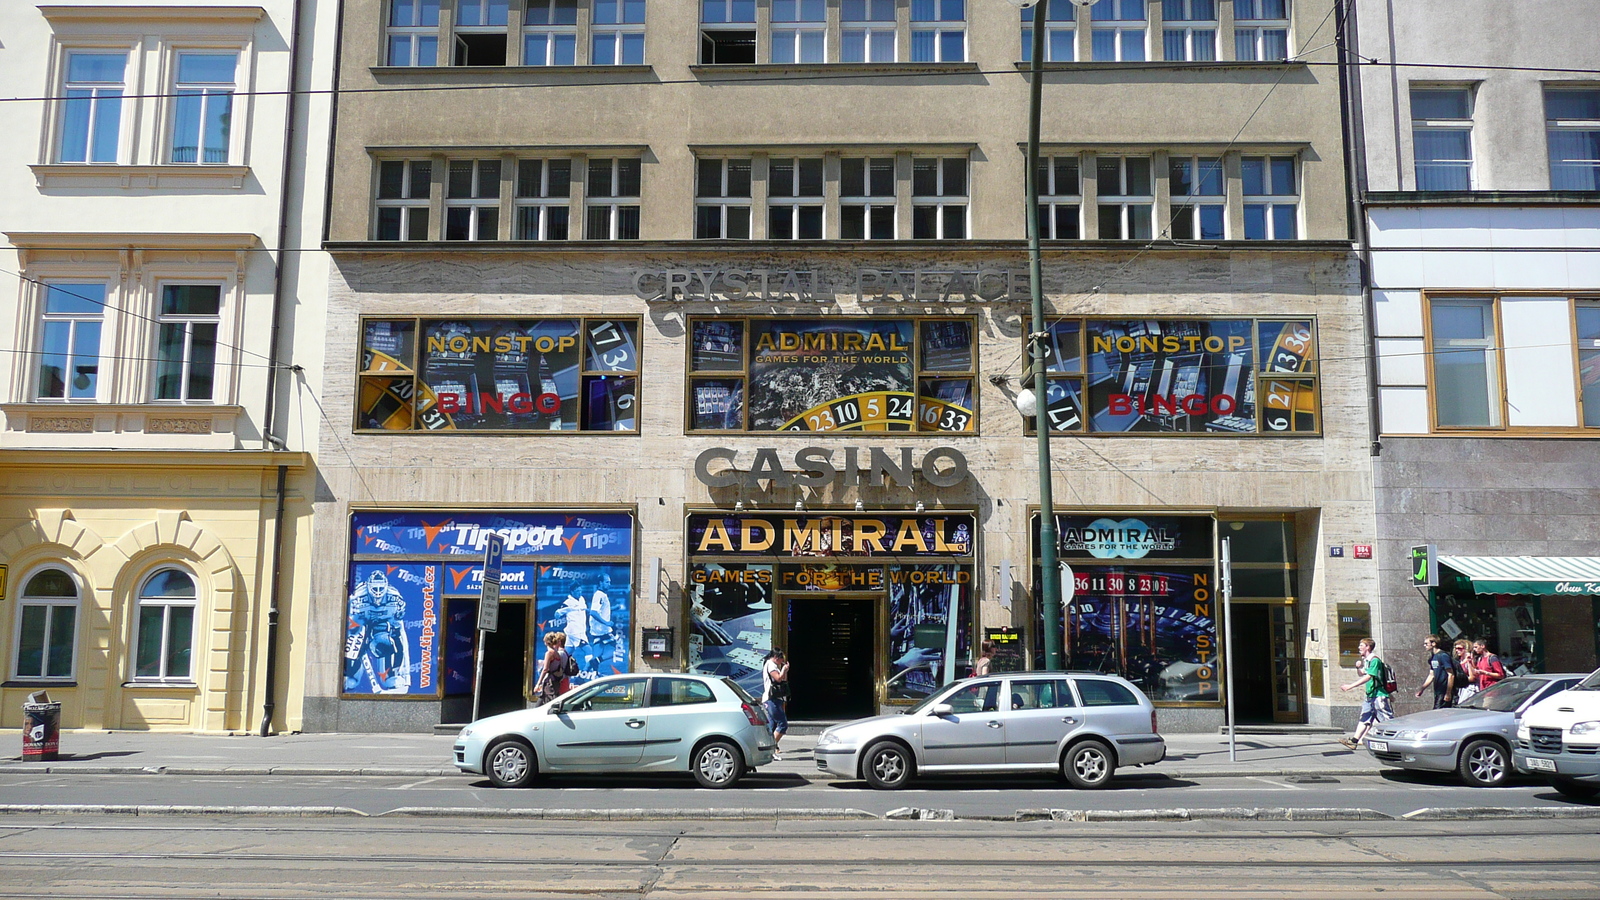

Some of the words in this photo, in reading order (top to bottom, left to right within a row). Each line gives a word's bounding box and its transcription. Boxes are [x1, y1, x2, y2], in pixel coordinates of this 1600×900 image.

[634, 268, 835, 301] CRYSTAL
[856, 268, 1032, 301] PALACE
[427, 336, 576, 353] NONSTOP
[756, 332, 909, 352] ADMIRAL
[1093, 335, 1246, 353] NONSTOP
[1285, 323, 1310, 354] 36
[755, 355, 799, 364] GAMES
[803, 355, 828, 364] FOR
[832, 355, 858, 364] THE
[862, 355, 909, 364] WORLD
[437, 392, 562, 414] BINGO
[1107, 393, 1237, 416] BINGO
[809, 410, 836, 431] 23
[833, 402, 858, 424] 10
[867, 399, 880, 417] 5
[888, 398, 912, 417] 24
[919, 403, 940, 424] 16
[939, 410, 968, 431] 33
[694, 446, 968, 487] CASINO
[456, 523, 564, 551] Tipsport
[697, 518, 967, 552] ADMIRAL
[1063, 527, 1175, 544] ADMIRAL
[489, 539, 501, 565] P
[1063, 543, 1096, 551] GAMES
[1099, 543, 1117, 551] FOR
[1120, 543, 1138, 551] THE
[1141, 543, 1175, 551] WORLD
[692, 570, 772, 584] GAMES
[782, 571, 826, 585] FOR
[837, 571, 880, 585] THE
[890, 571, 971, 584] WORLD
[1074, 578, 1089, 591] 36
[1091, 578, 1106, 591] 11
[1108, 578, 1123, 591] 30
[1128, 578, 1136, 591] 8
[1140, 579, 1151, 592] 23
[1152, 580, 1159, 591] 10
[420, 565, 437, 688] www.tipsport.cz
